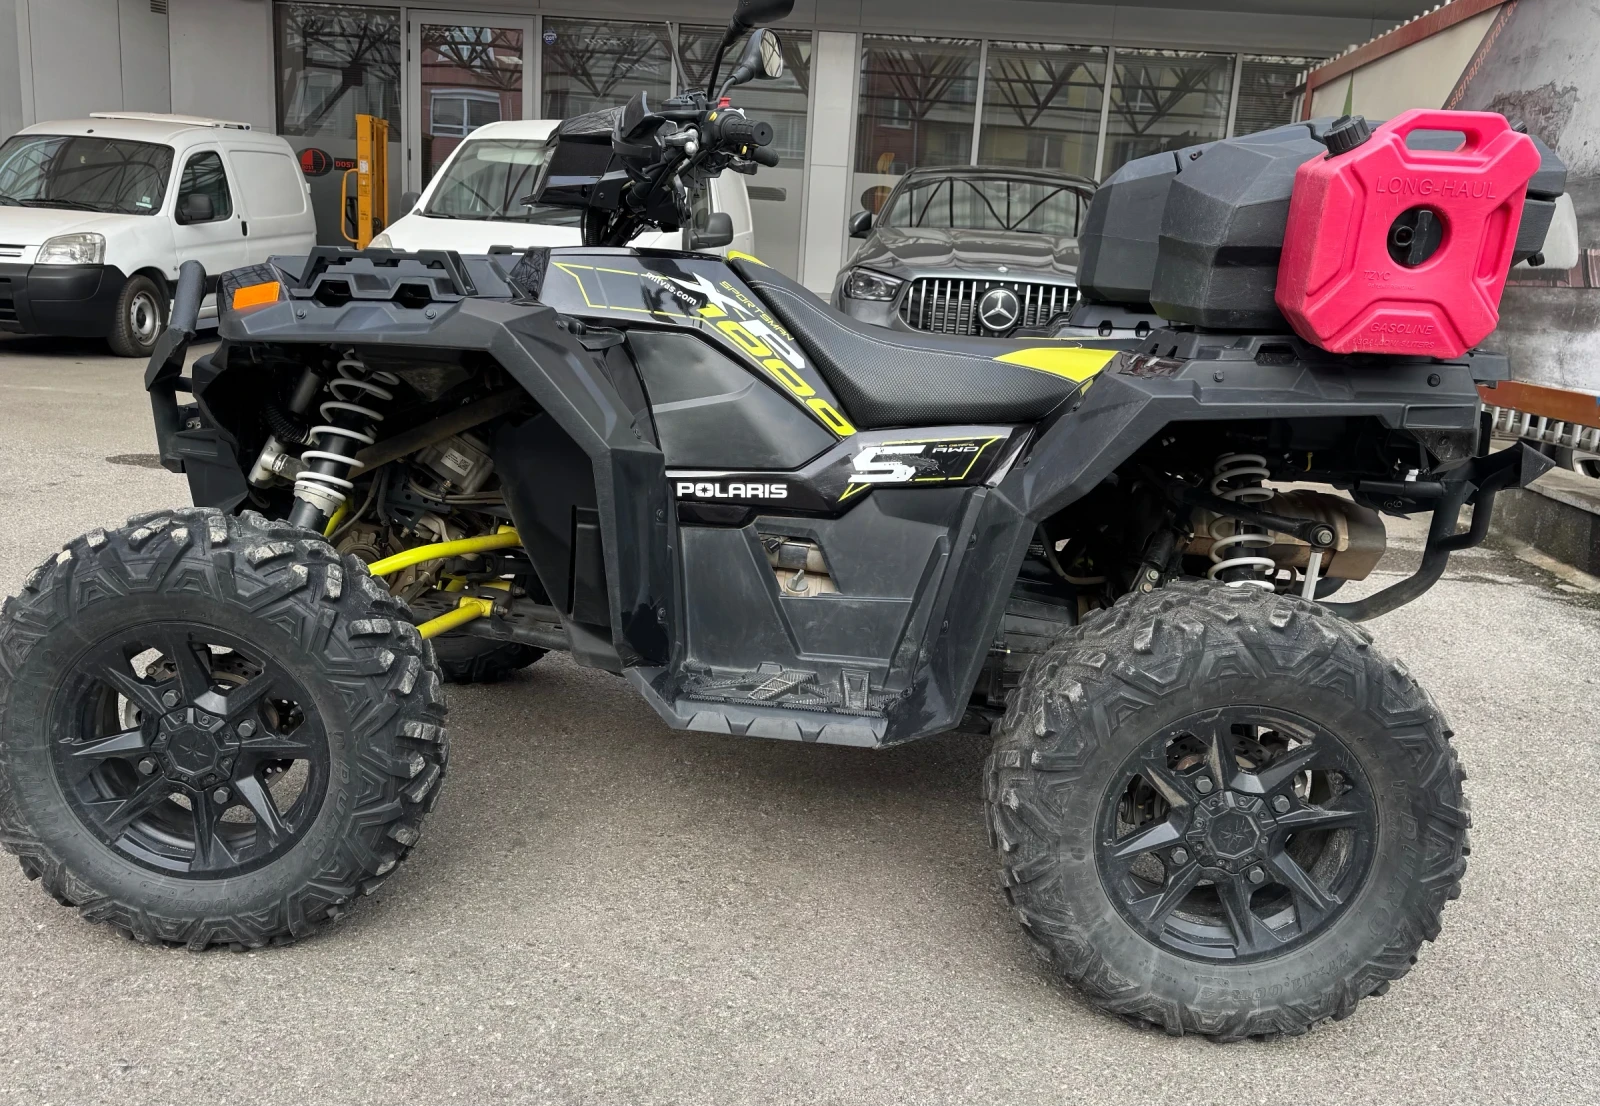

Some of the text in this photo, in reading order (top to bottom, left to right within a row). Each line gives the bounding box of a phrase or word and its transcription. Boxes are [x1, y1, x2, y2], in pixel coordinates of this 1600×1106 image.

[335, 160, 355, 168] DOST
[1375, 175, 1497, 199] LONG-HAUL
[1363, 270, 1392, 280] TZYC
[666, 271, 806, 370] XP
[719, 280, 795, 341] SPORTSMAN
[1370, 322, 1435, 335] GASOLINE
[696, 302, 858, 437] 1000
[676, 482, 789, 499] POLARIS
